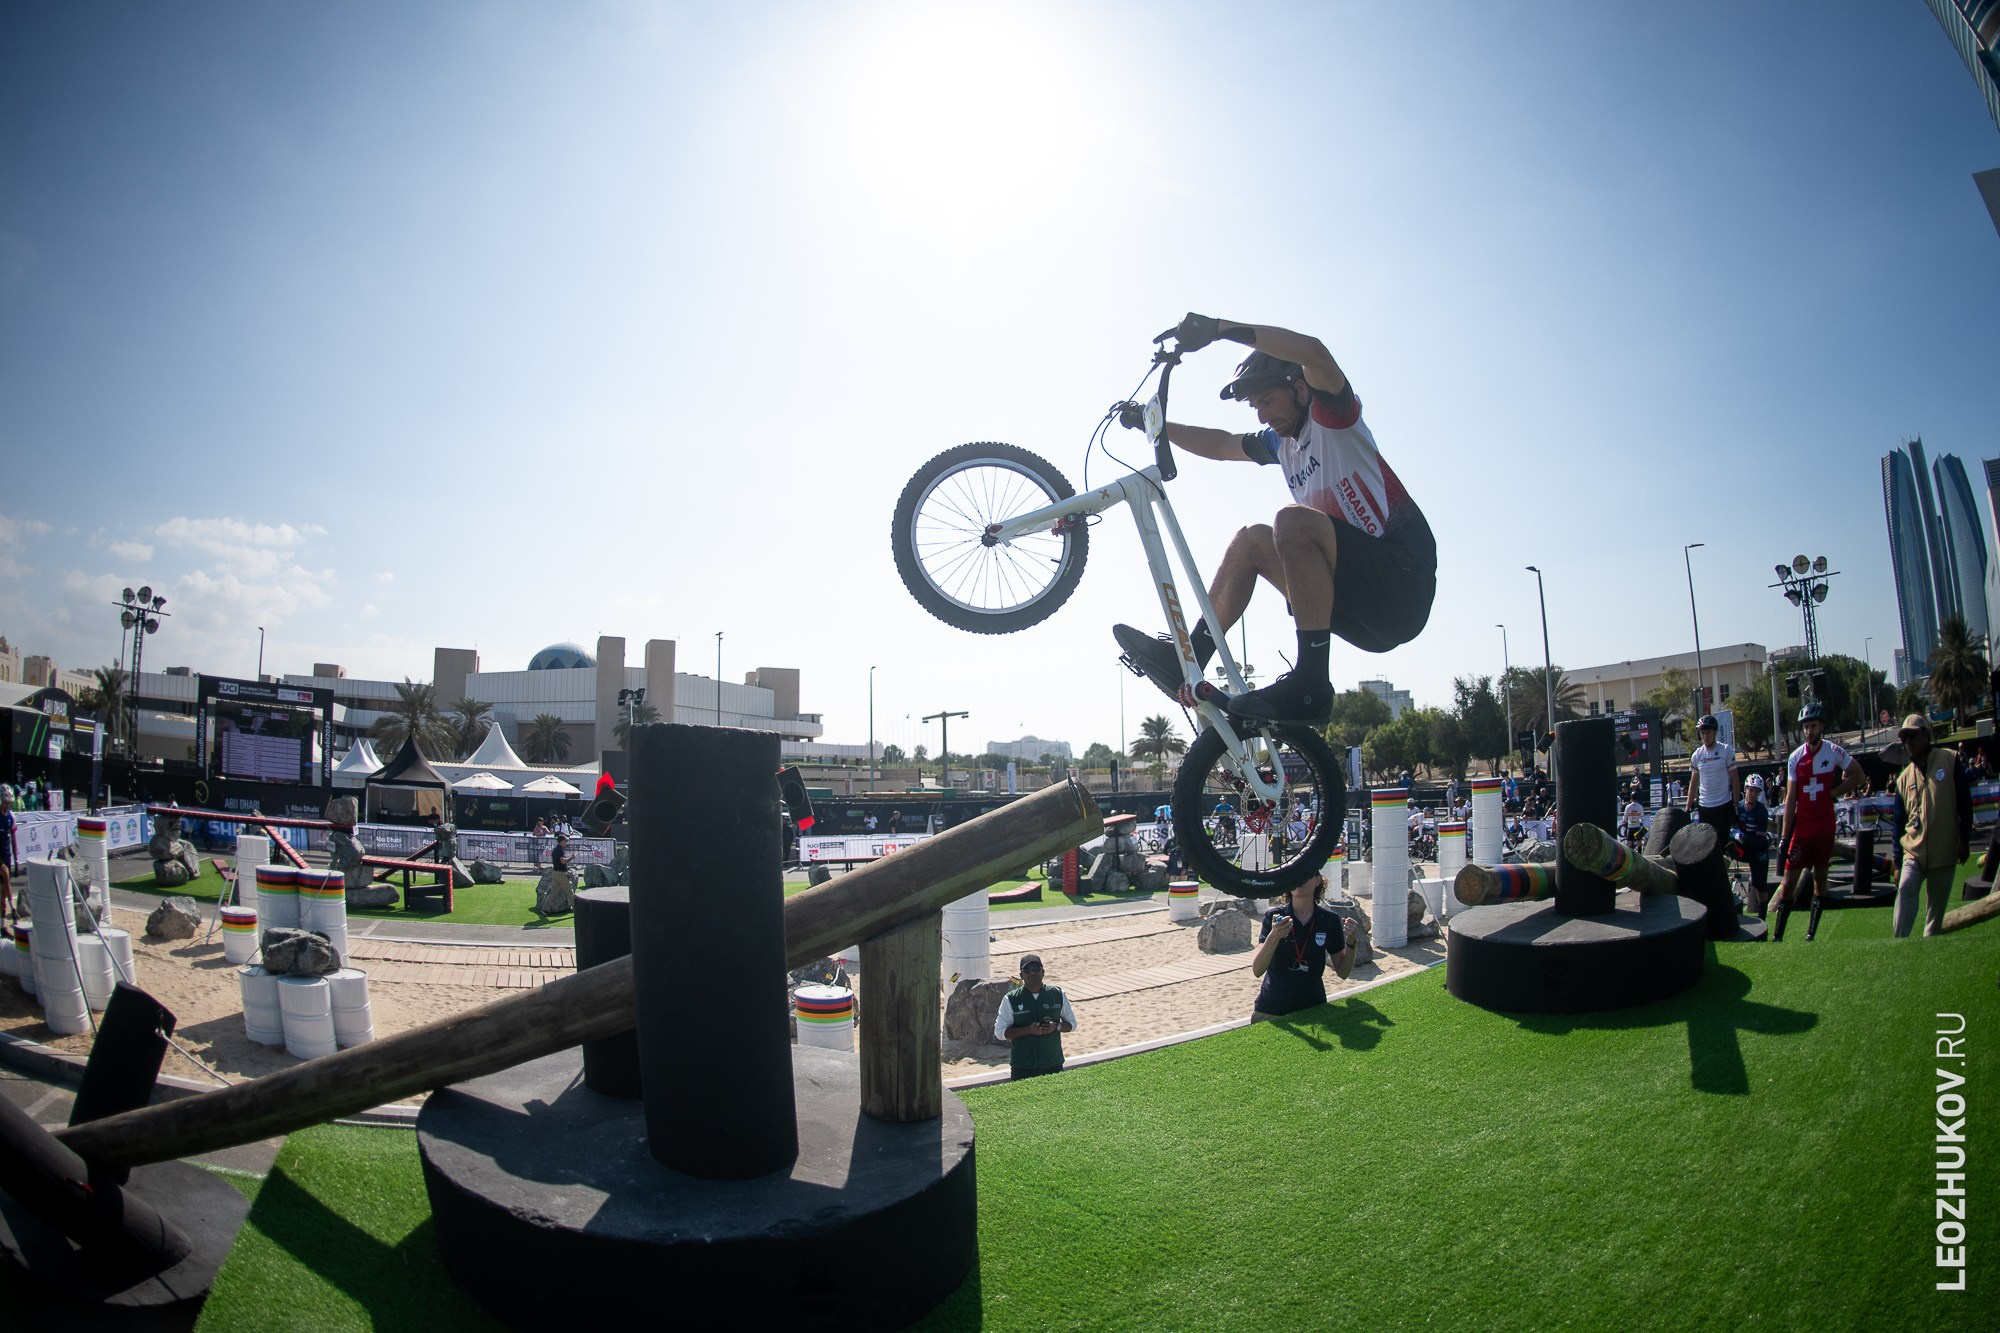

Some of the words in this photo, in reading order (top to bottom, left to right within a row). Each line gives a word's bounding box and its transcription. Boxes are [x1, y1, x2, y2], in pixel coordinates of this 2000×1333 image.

[1335, 482, 1345, 502] WORK
[1344, 502, 1352, 512] ON
[1340, 477, 1377, 535] STRABAG
[222, 683, 238, 693] UCI
[224, 798, 238, 809] ABU
[239, 799, 260, 810] DHABI
[303, 805, 320, 813] Dhabi
